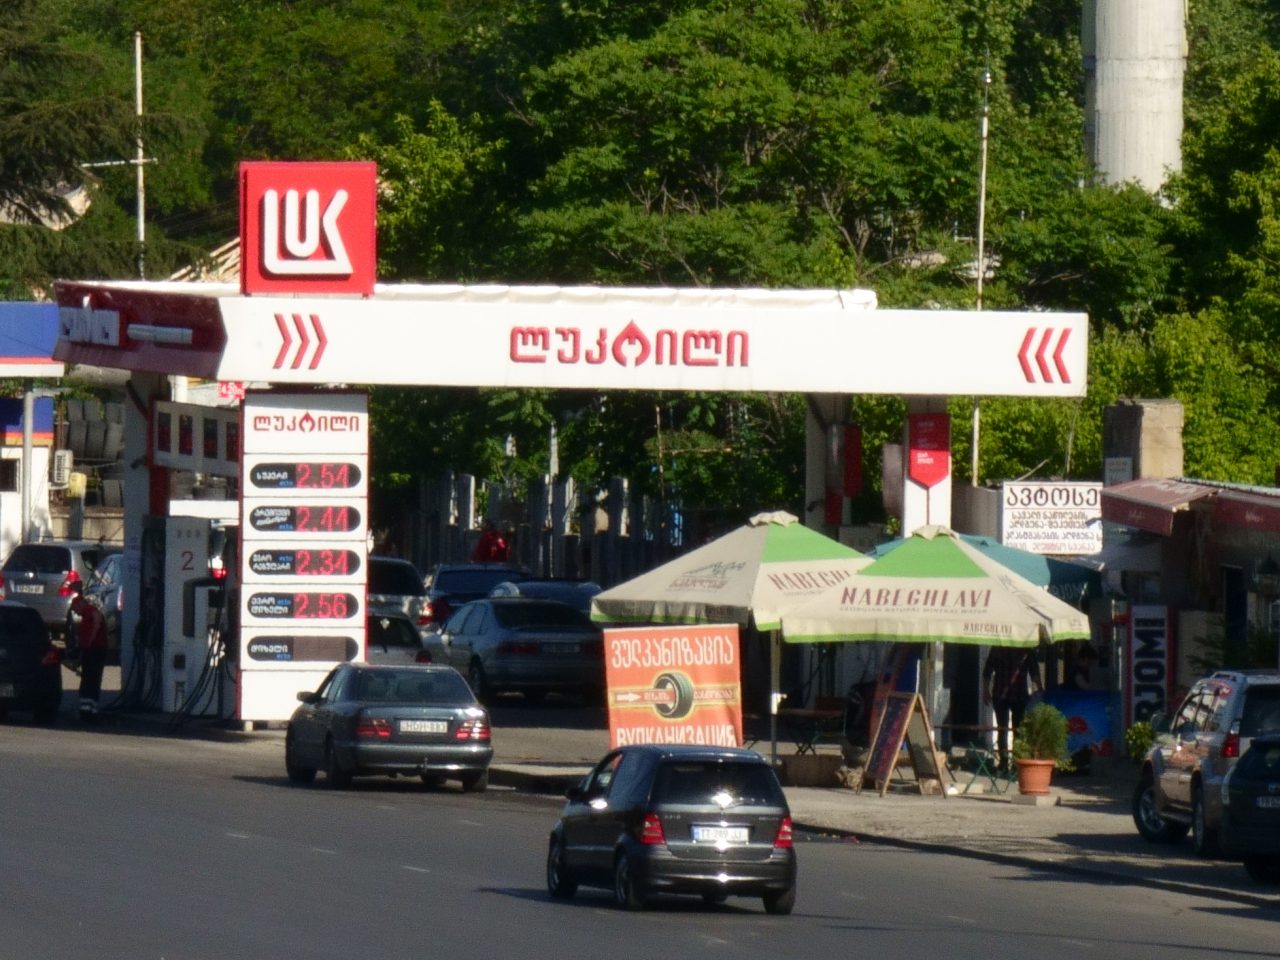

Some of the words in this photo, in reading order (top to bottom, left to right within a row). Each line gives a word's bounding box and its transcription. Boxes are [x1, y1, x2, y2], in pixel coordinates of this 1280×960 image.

[263, 189, 354, 274] LUK
[510, 319, 749, 367] ლუკოილი
[253, 411, 359, 433] ლუკოილი
[296, 463, 349, 489] 2.54
[181, 551, 194, 570] 2
[295, 549, 348, 575] 2.34
[293, 592, 347, 618] 2.56
[840, 586, 992, 608] NABEGHLAVI
[611, 635, 734, 668] ვულკანიზაცია
